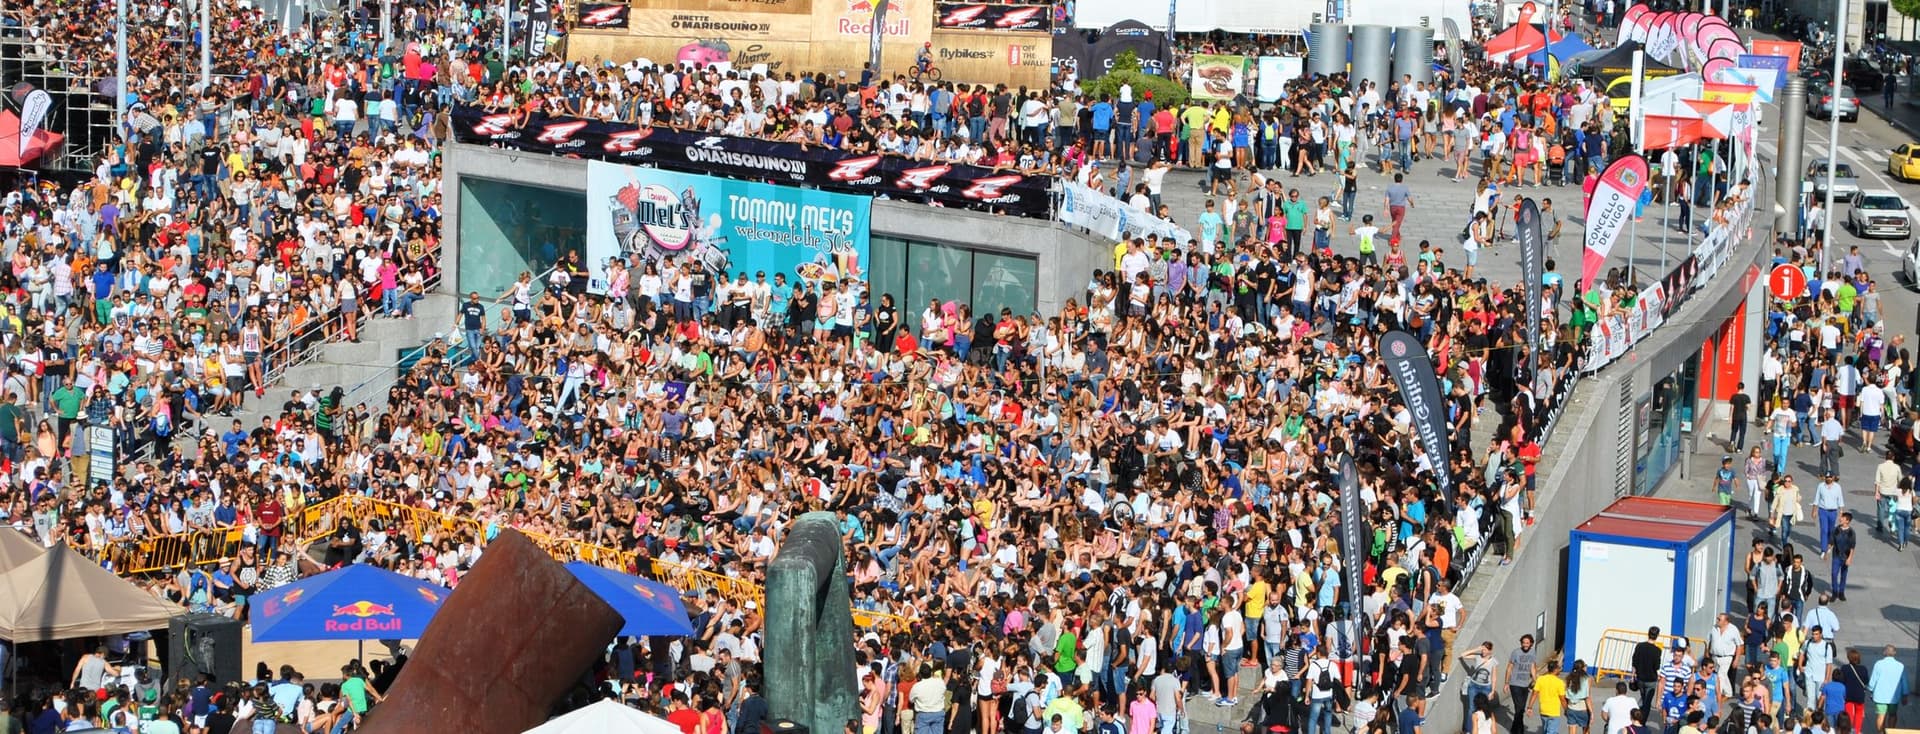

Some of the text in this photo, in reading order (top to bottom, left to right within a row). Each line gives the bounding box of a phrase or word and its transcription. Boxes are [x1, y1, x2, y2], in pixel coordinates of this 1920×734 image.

[530, 20, 548, 57] VANS
[839, 18, 873, 34] Red
[940, 48, 987, 60] flybikes
[729, 195, 853, 236] TOMMY MEL'S
[1588, 192, 1619, 247] CONCELLO
[1599, 204, 1625, 246] DE VIGO
[735, 217, 852, 254] welcome to the 50's
[325, 618, 402, 632] Red Bull
